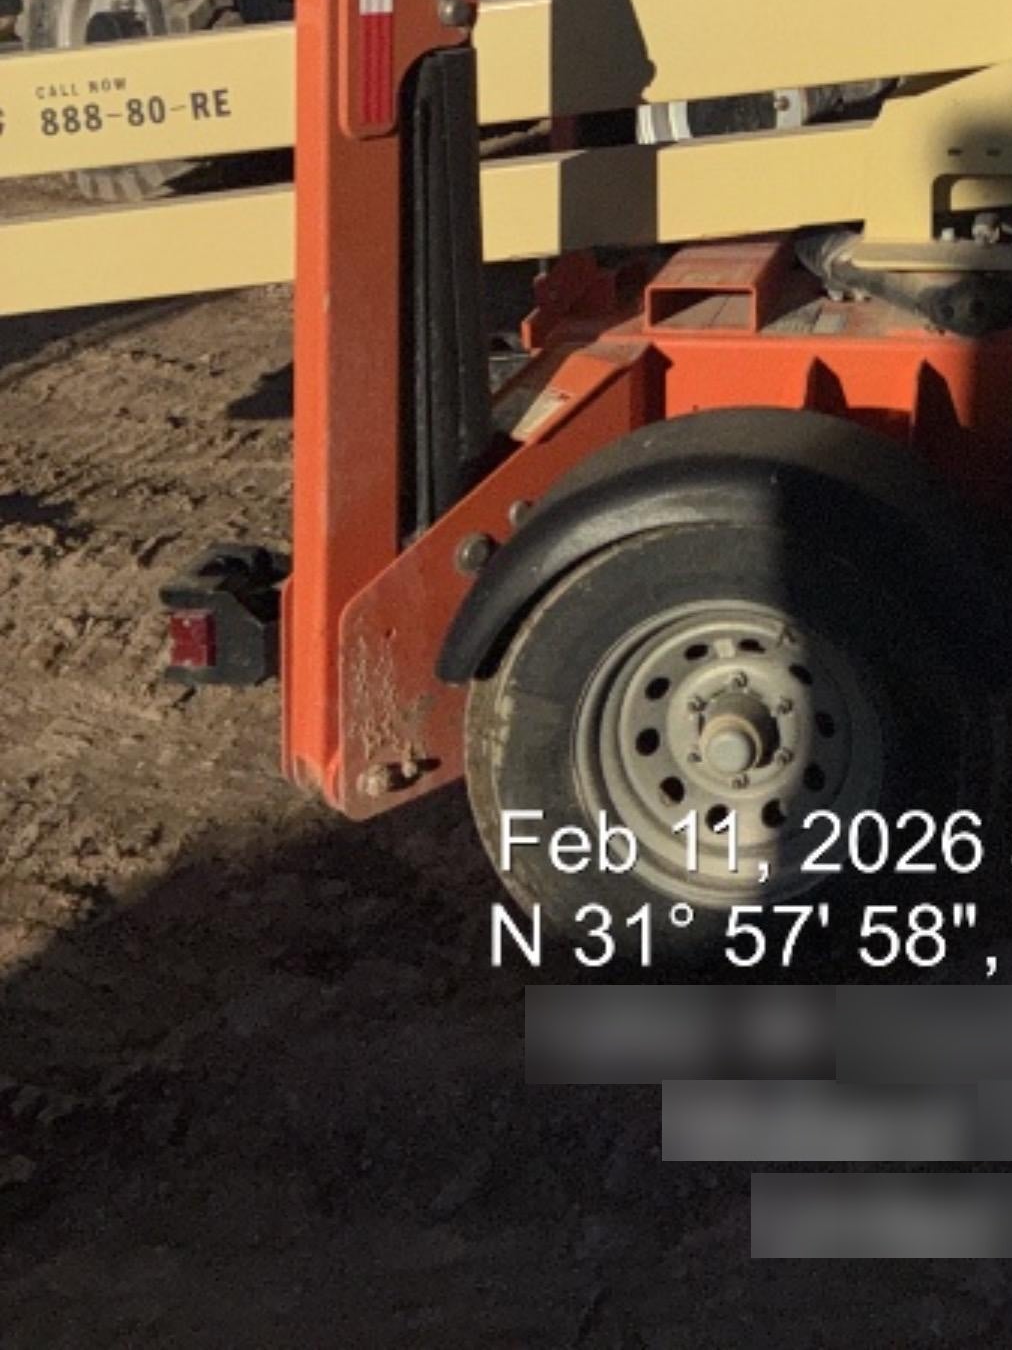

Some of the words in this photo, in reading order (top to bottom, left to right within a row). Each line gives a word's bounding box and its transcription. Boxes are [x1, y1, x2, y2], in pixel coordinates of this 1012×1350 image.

[35, 83, 80, 100] CALL
[89, 77, 127, 94] NOW
[40, 88, 232, 137] 888-80-RE
